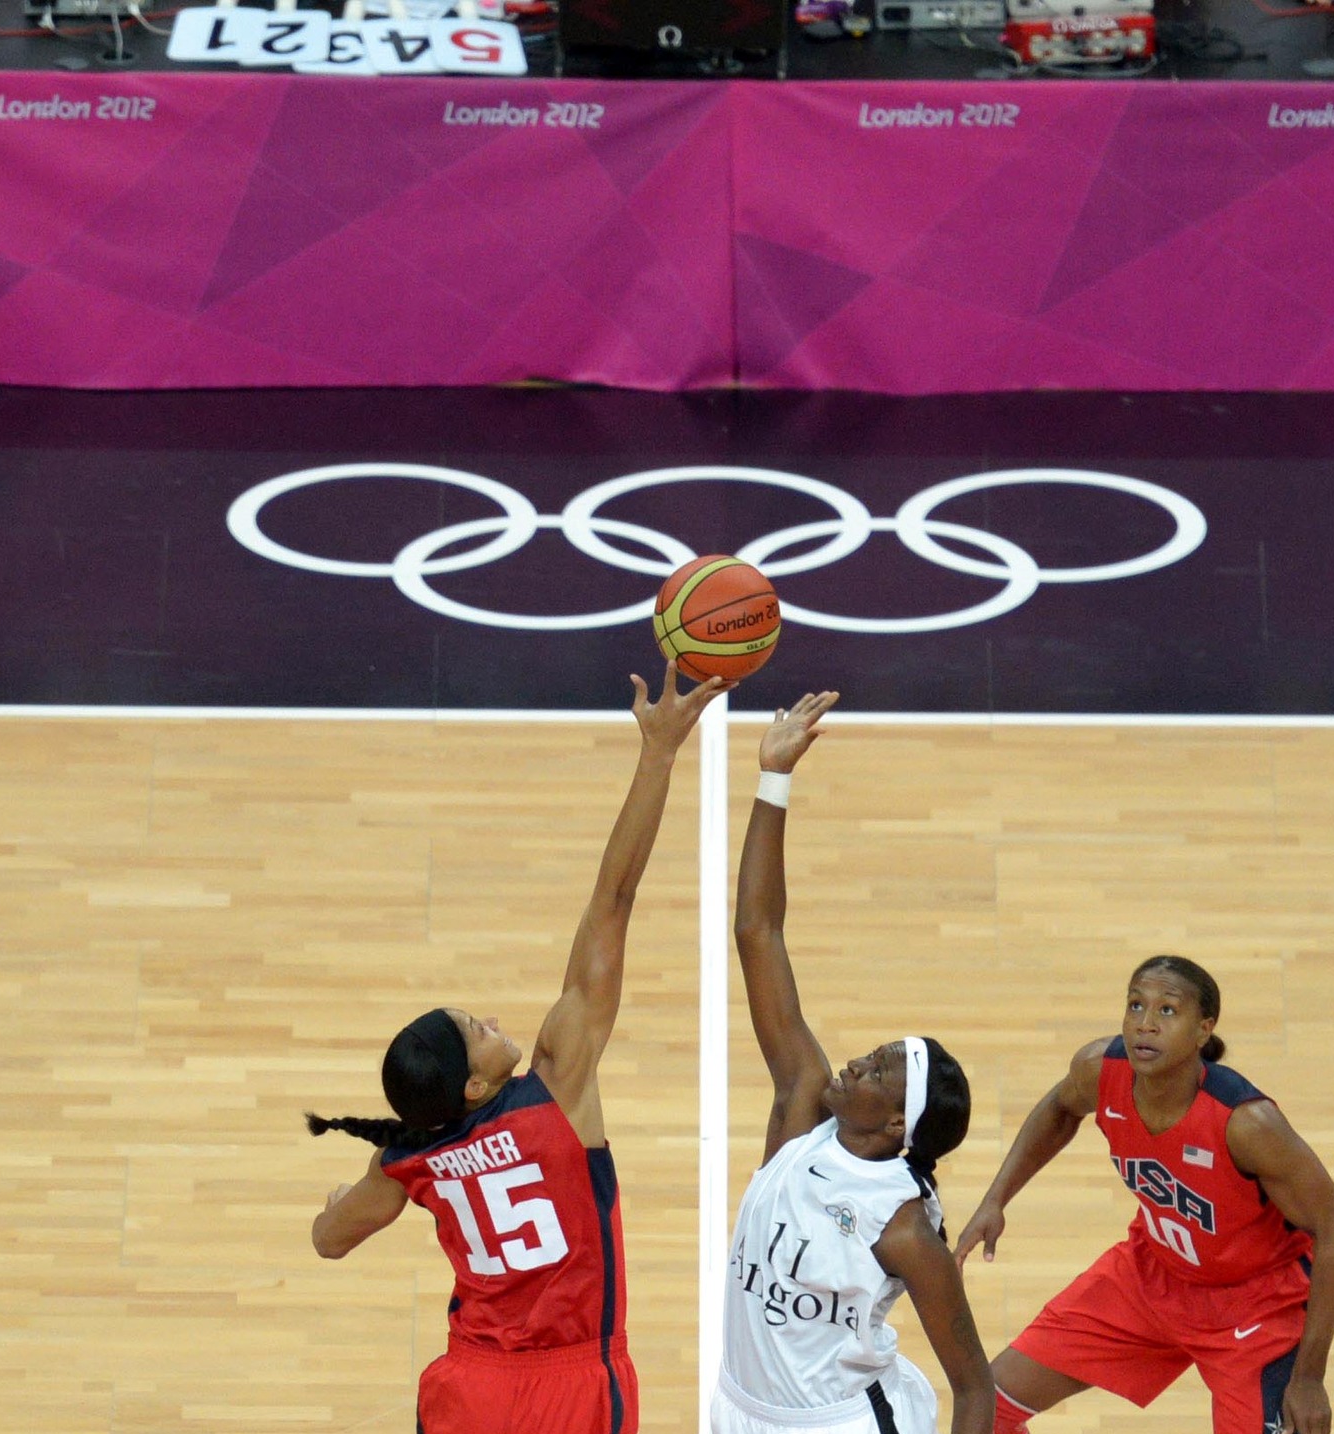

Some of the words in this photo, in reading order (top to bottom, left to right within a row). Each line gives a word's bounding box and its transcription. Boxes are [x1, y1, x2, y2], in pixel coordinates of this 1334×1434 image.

[207, 18, 235, 50] 1
[262, 22, 306, 54] 2
[328, 32, 364, 63] 3
[381, 29, 430, 63] 4
[450, 29, 502, 63] 5
[96, 97, 156, 120] 2012
[444, 102, 539, 126] London
[545, 103, 605, 128] 2012
[858, 104, 954, 128] London
[960, 103, 1020, 127] 2012
[708, 611, 764, 635] London
[426, 1131, 522, 1178] PARKER
[1110, 1156, 1216, 1235] USA
[434, 1163, 569, 1275] 15
[1140, 1202, 1201, 1267] 10
[731, 1236, 861, 1340] Angola
